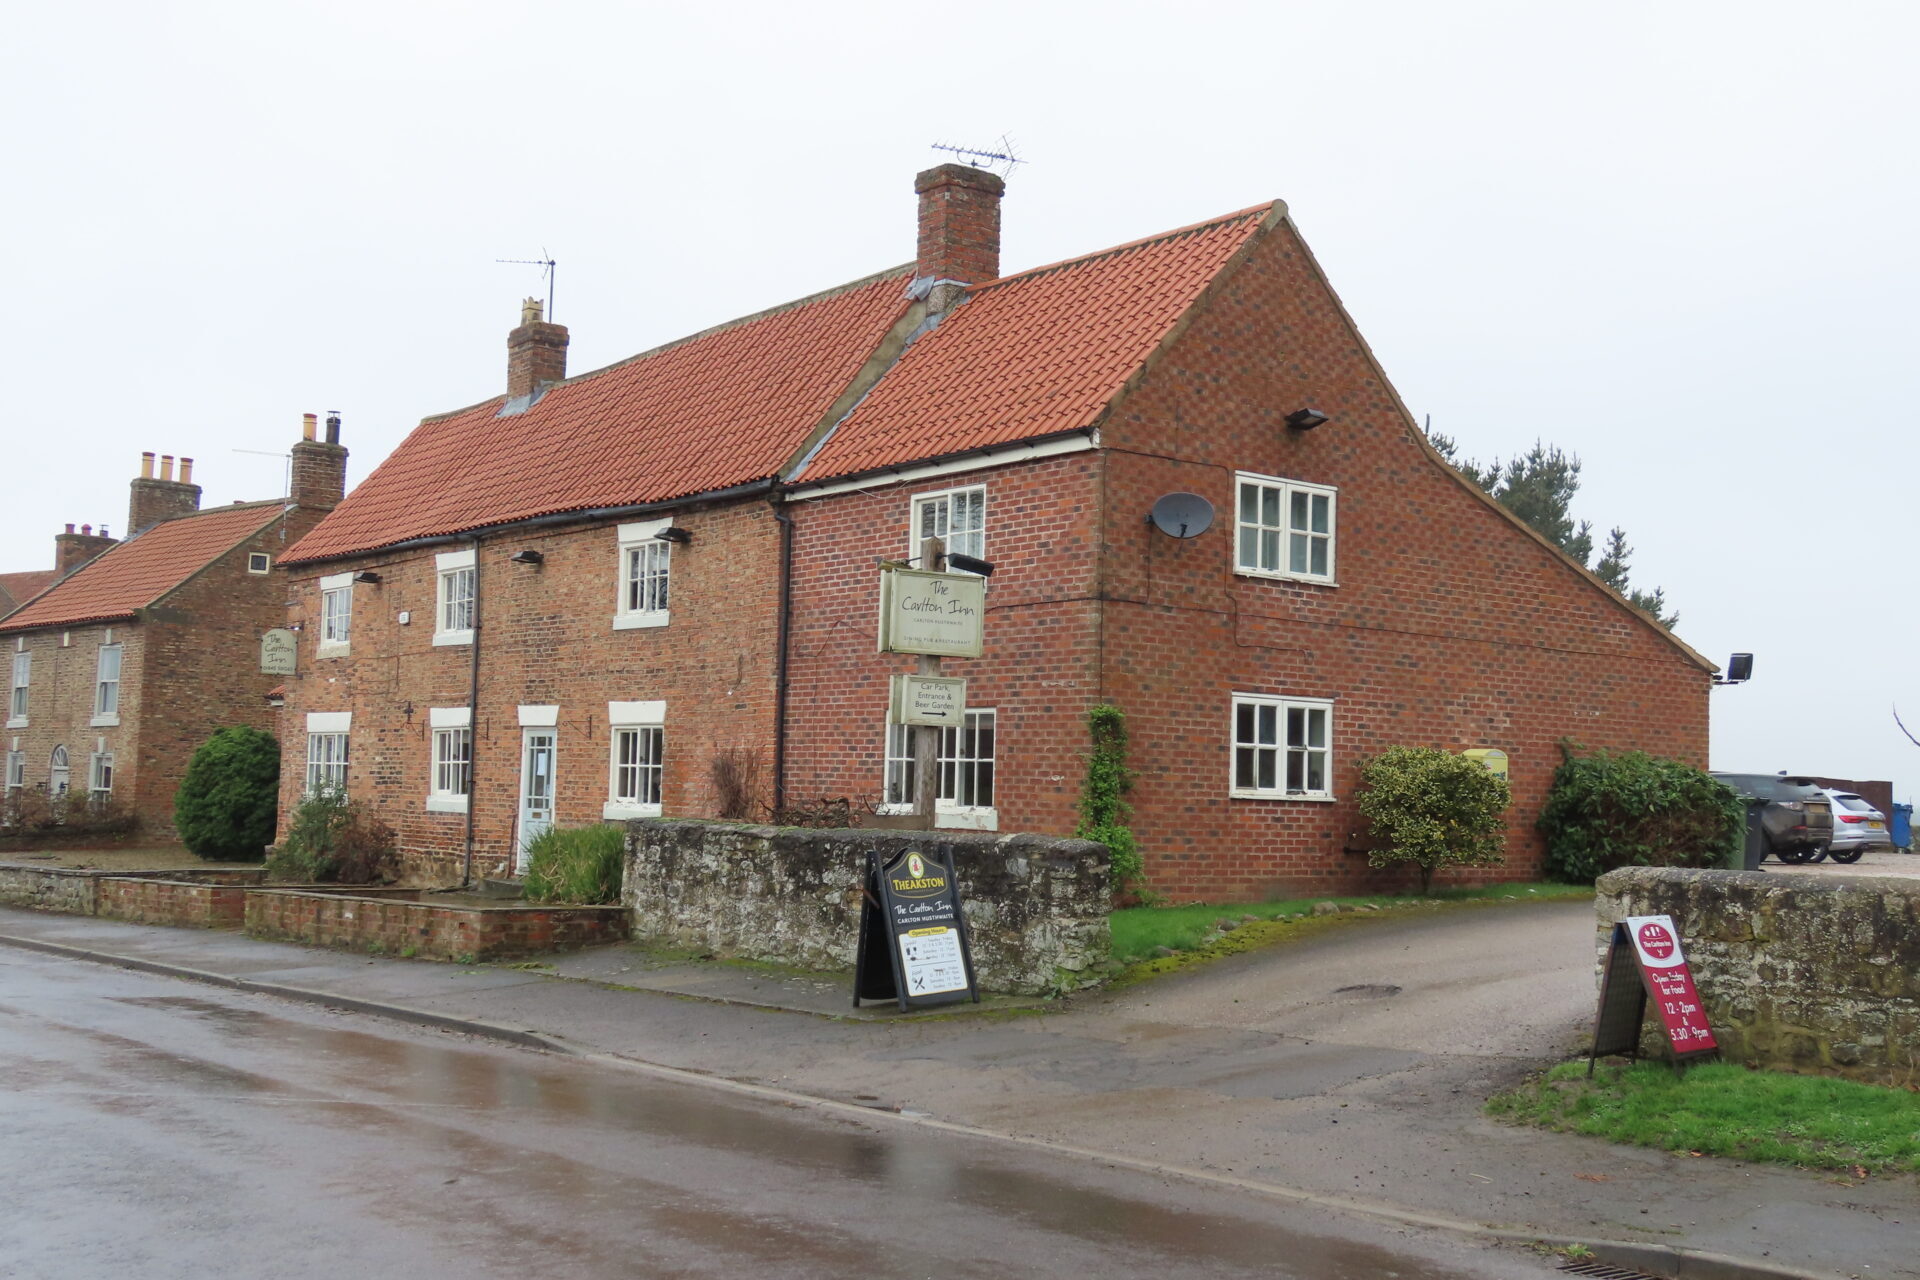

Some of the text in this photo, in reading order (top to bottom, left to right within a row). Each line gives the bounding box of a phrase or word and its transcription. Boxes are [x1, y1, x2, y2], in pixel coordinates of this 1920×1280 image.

[930, 580, 949, 595] The
[902, 596, 975, 616] Carlton Inn
[267, 634, 280, 643] The
[265, 643, 294, 654] Carlton
[267, 653, 286, 663] Inn
[920, 682, 933, 690] Car
[918, 691, 945, 700] Entrance
[915, 700, 954, 710] Beer Garden
[893, 877, 945, 891] THEAKSTON
[894, 900, 953, 915] The Carlton Inn
[897, 916, 921, 924] CARLTON
[1652, 971, 1686, 984] Open Today
[1661, 984, 1686, 995] for Food
[1665, 1002, 1676, 1014] 12
[1679, 1001, 1696, 1016] 2pm
[1682, 1016, 1689, 1026] &
[1670, 1028, 1688, 1041] 5.30
[1691, 1026, 1709, 1041] 9pm
